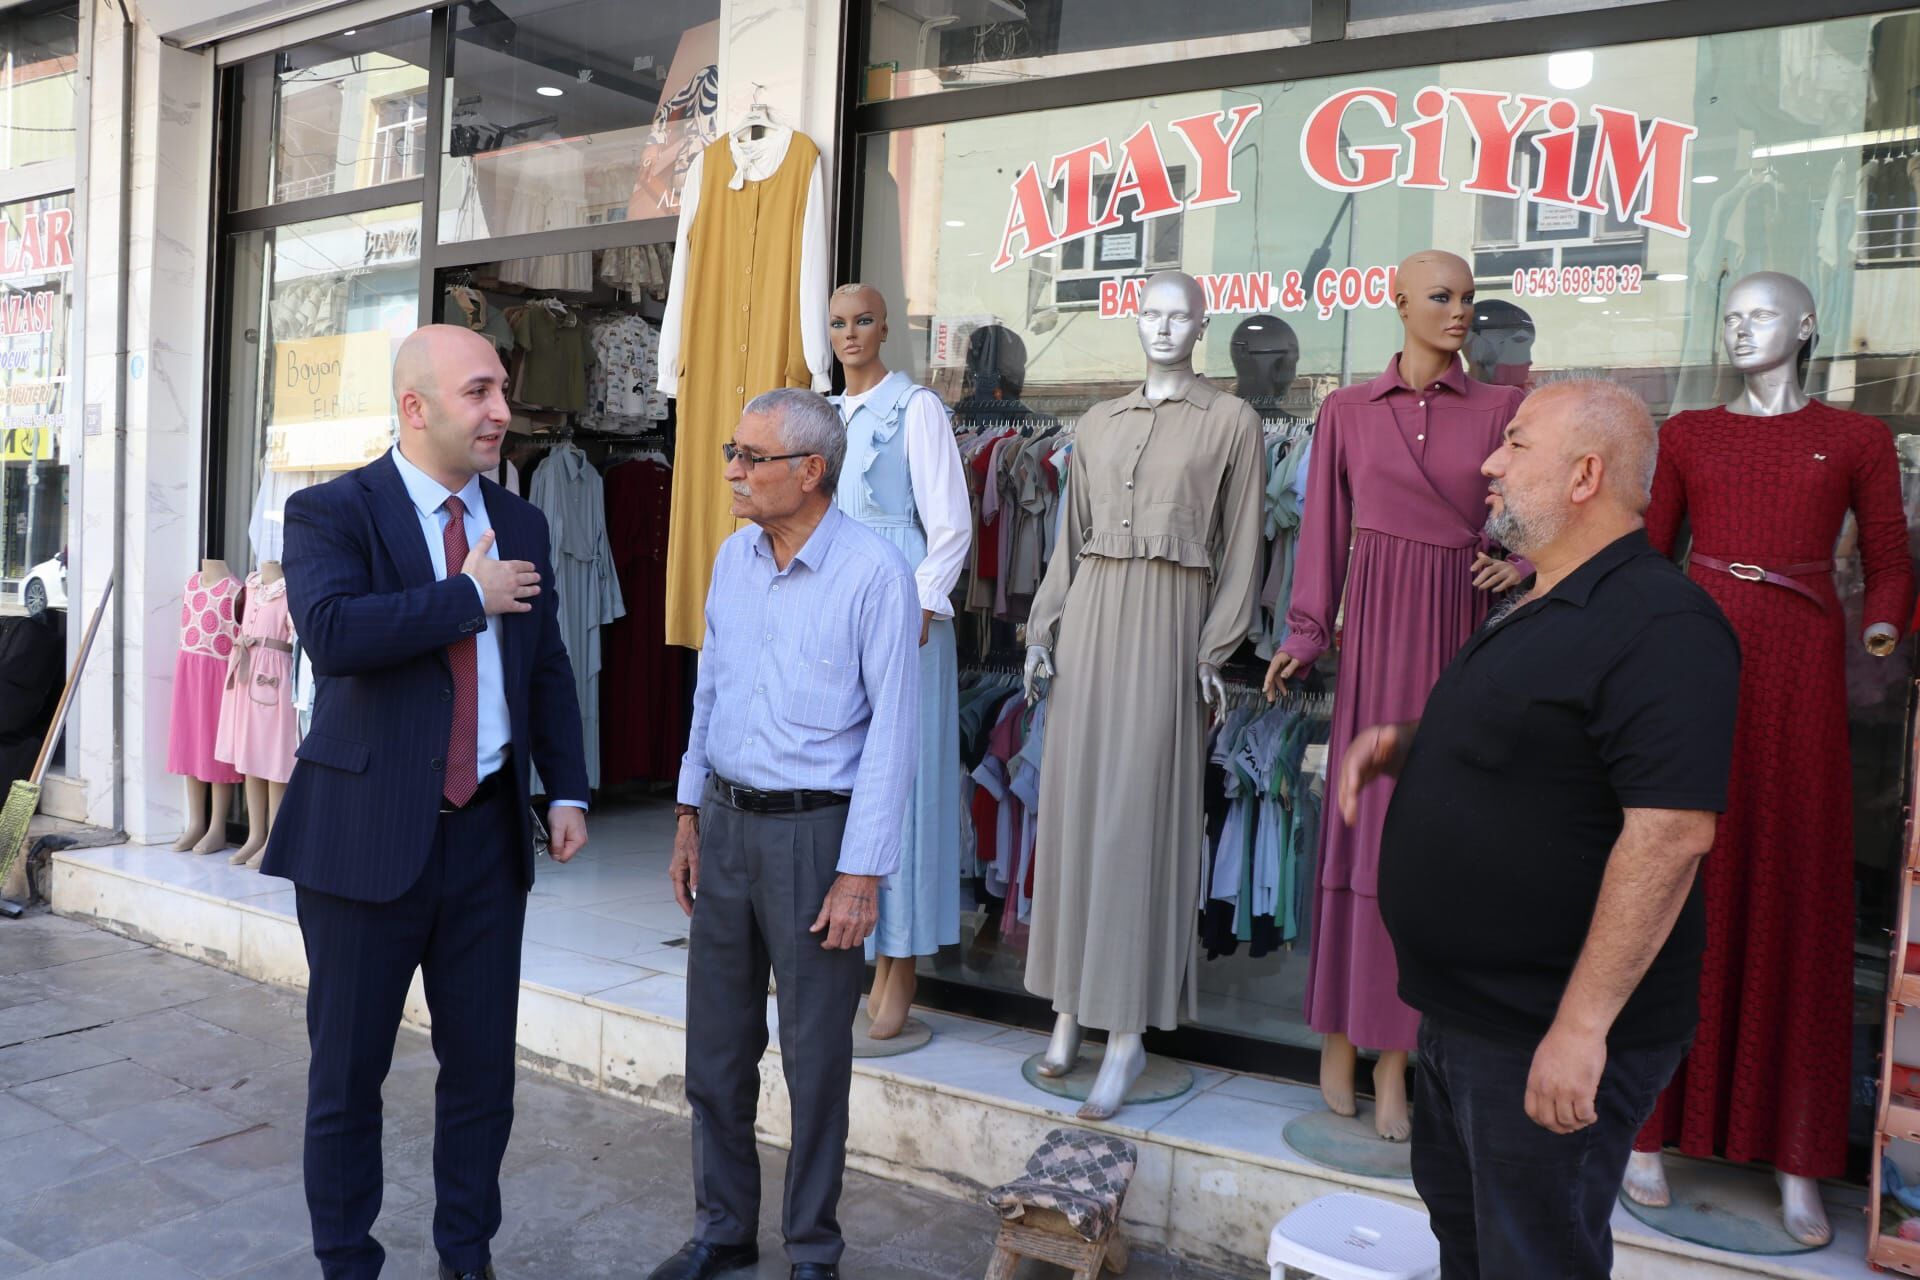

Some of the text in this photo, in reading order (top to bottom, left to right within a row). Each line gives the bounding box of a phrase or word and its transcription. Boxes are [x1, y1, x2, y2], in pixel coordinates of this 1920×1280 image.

[657, 187, 682, 209] AL
[992, 104, 1262, 272] ATAY
[1194, 273, 1272, 314] YAN
[1281, 270, 1305, 312] &
[1513, 264, 1641, 296] 0 543 698 58 32
[0, 350, 29, 370] OCUK
